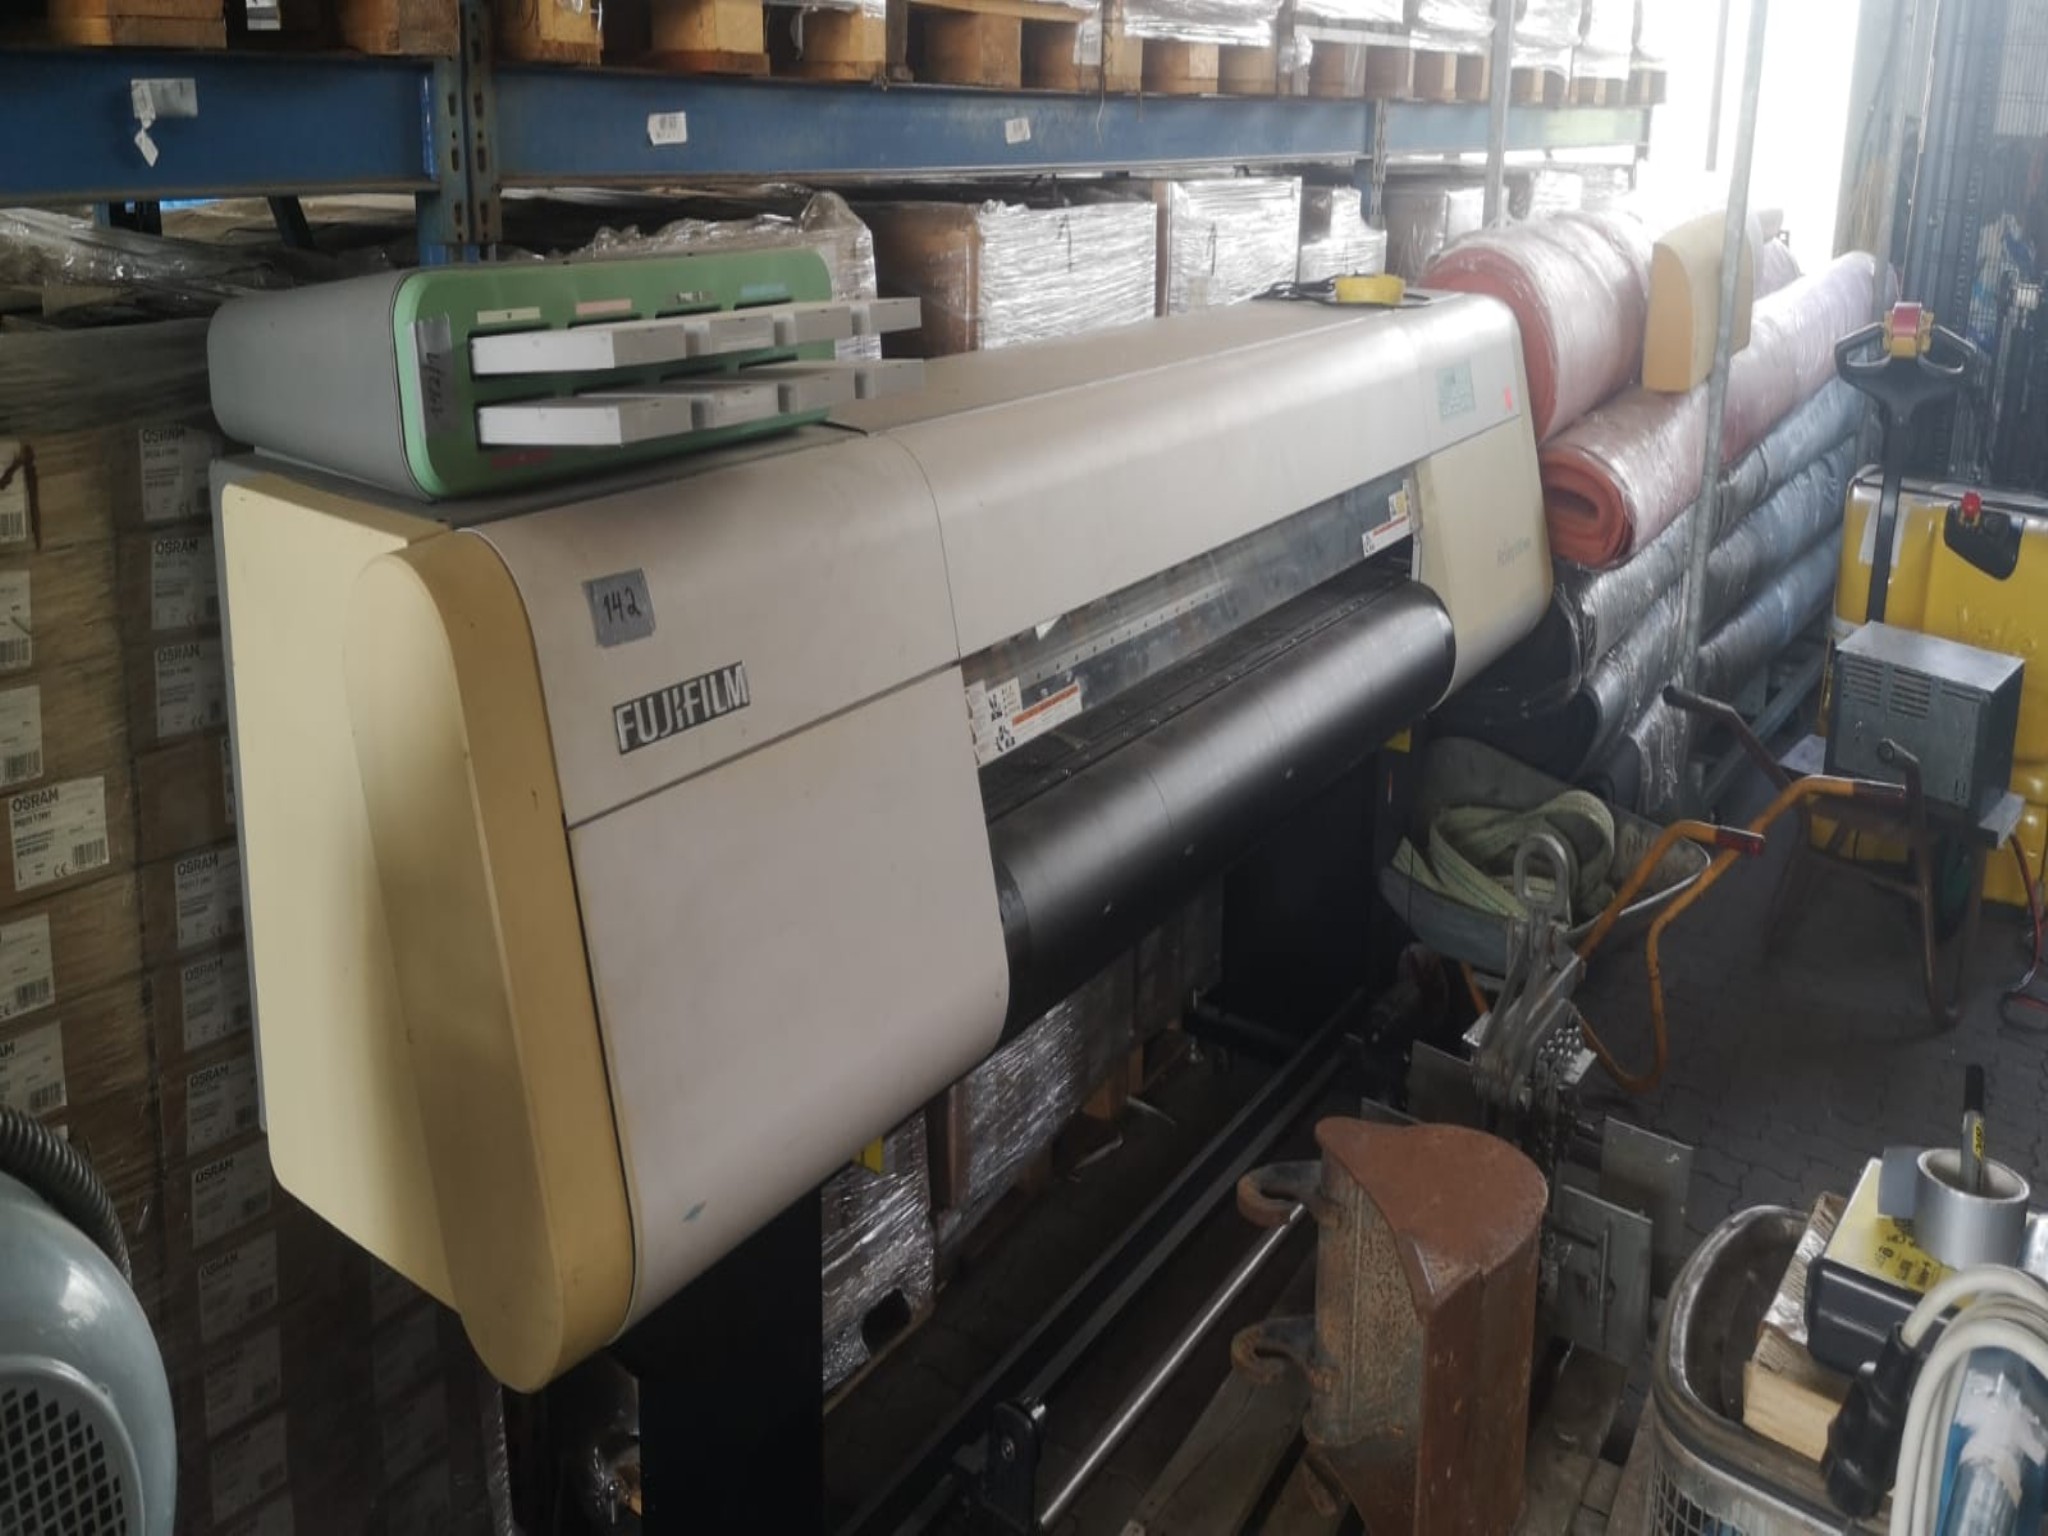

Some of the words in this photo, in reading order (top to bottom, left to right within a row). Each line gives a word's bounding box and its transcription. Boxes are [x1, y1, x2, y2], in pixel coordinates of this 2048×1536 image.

[155, 538, 198, 555] OSRAM
[603, 588, 641, 623] 142
[616, 664, 749, 752] FUJIFILM
[12, 788, 59, 812] OSRAM
[177, 854, 218, 876] OSRAM
